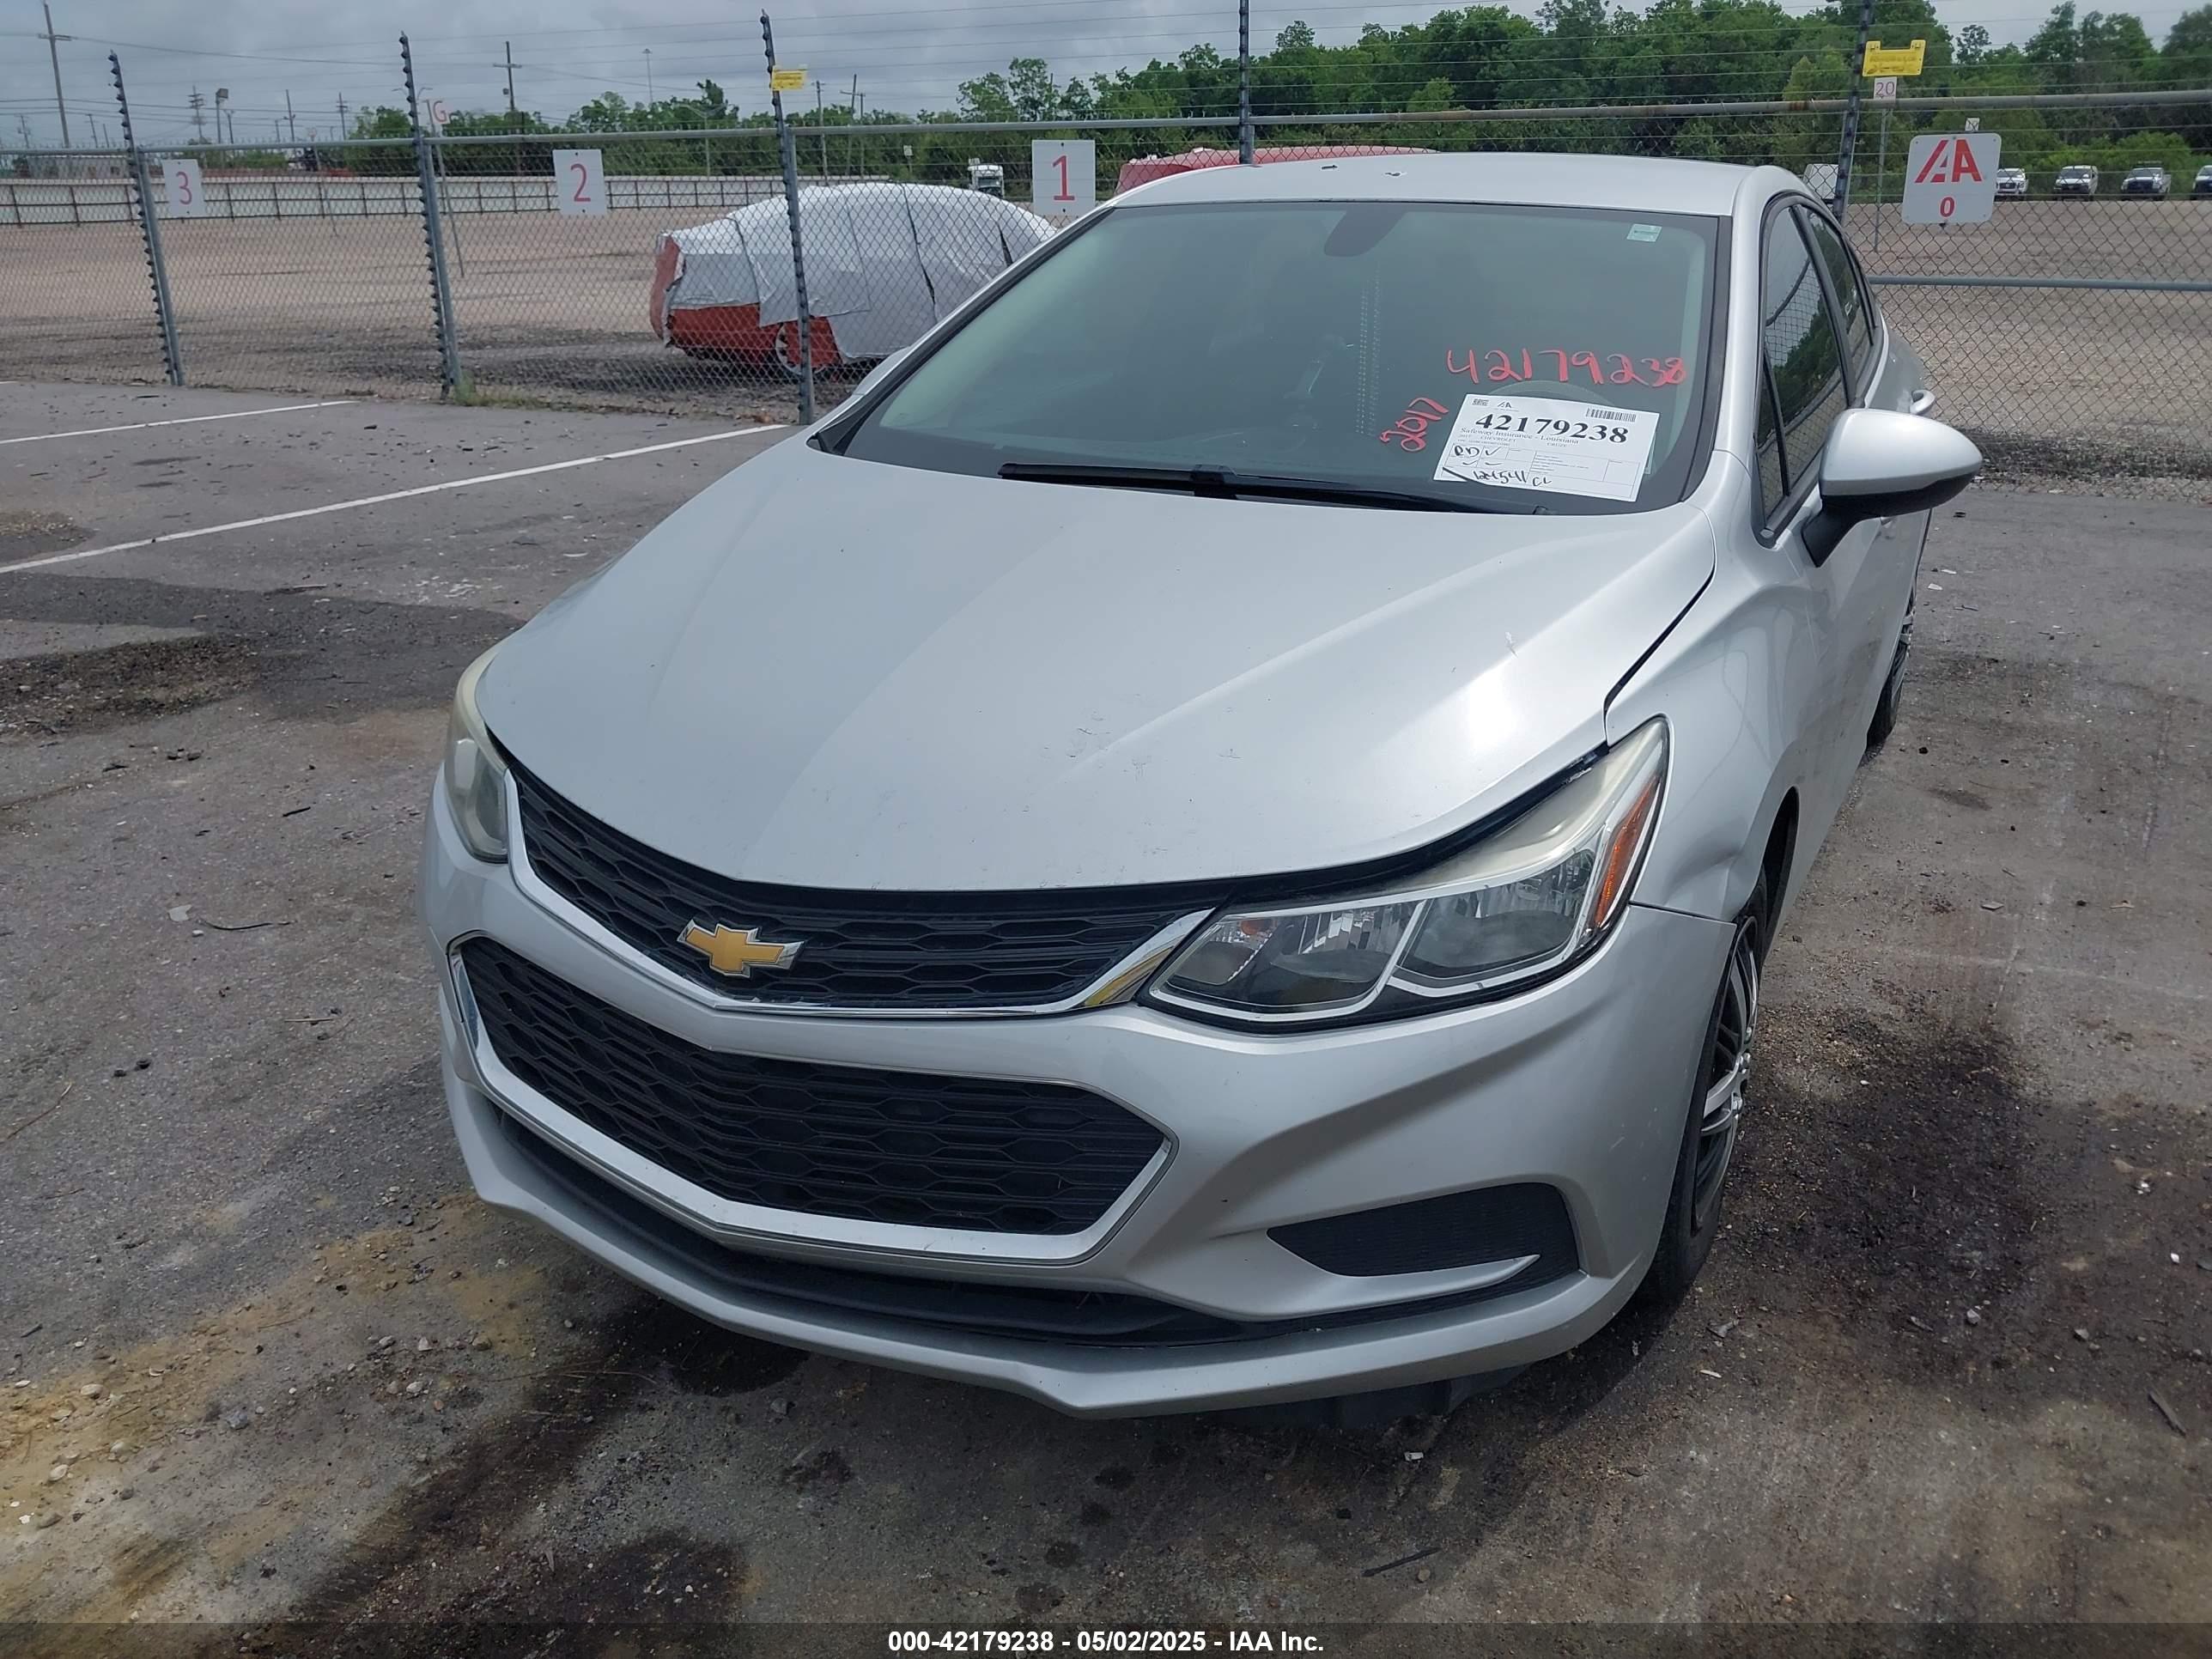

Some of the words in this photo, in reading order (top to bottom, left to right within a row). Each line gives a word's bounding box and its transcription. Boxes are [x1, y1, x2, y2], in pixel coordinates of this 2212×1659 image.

[1875, 81, 1895, 97] 20
[175, 171, 192, 205] 3
[570, 163, 592, 203] 2
[1052, 155, 1075, 201] 1
[1445, 347, 1687, 387] 42179238
[1379, 397, 1449, 453] 2017
[1461, 427, 1493, 435] Safeway
[1540, 435, 1579, 444] Louisiana
[1474, 413, 1629, 443] 42179238
